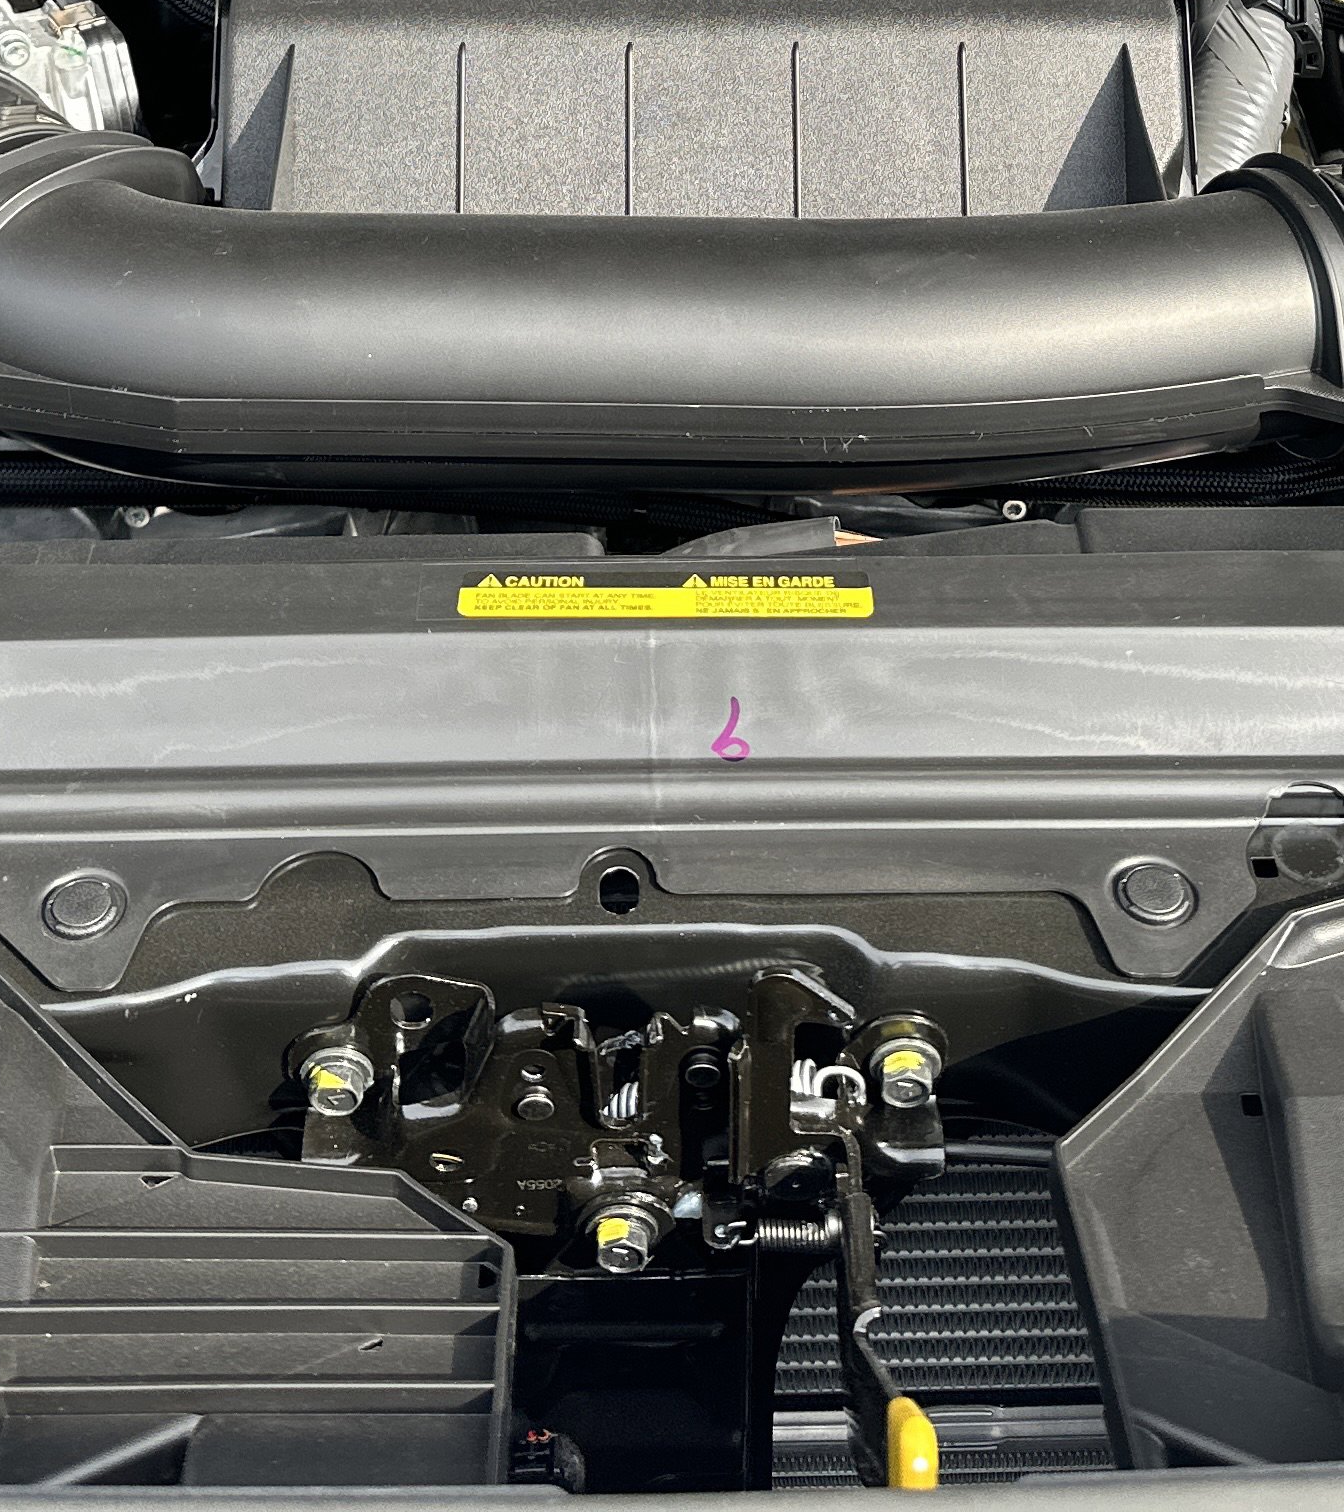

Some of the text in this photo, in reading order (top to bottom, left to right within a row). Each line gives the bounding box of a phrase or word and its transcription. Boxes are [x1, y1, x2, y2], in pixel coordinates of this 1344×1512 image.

[504, 575, 585, 588] CAUTION
[709, 575, 836, 588] MISE EN GARDE
[710, 696, 751, 762] 6
